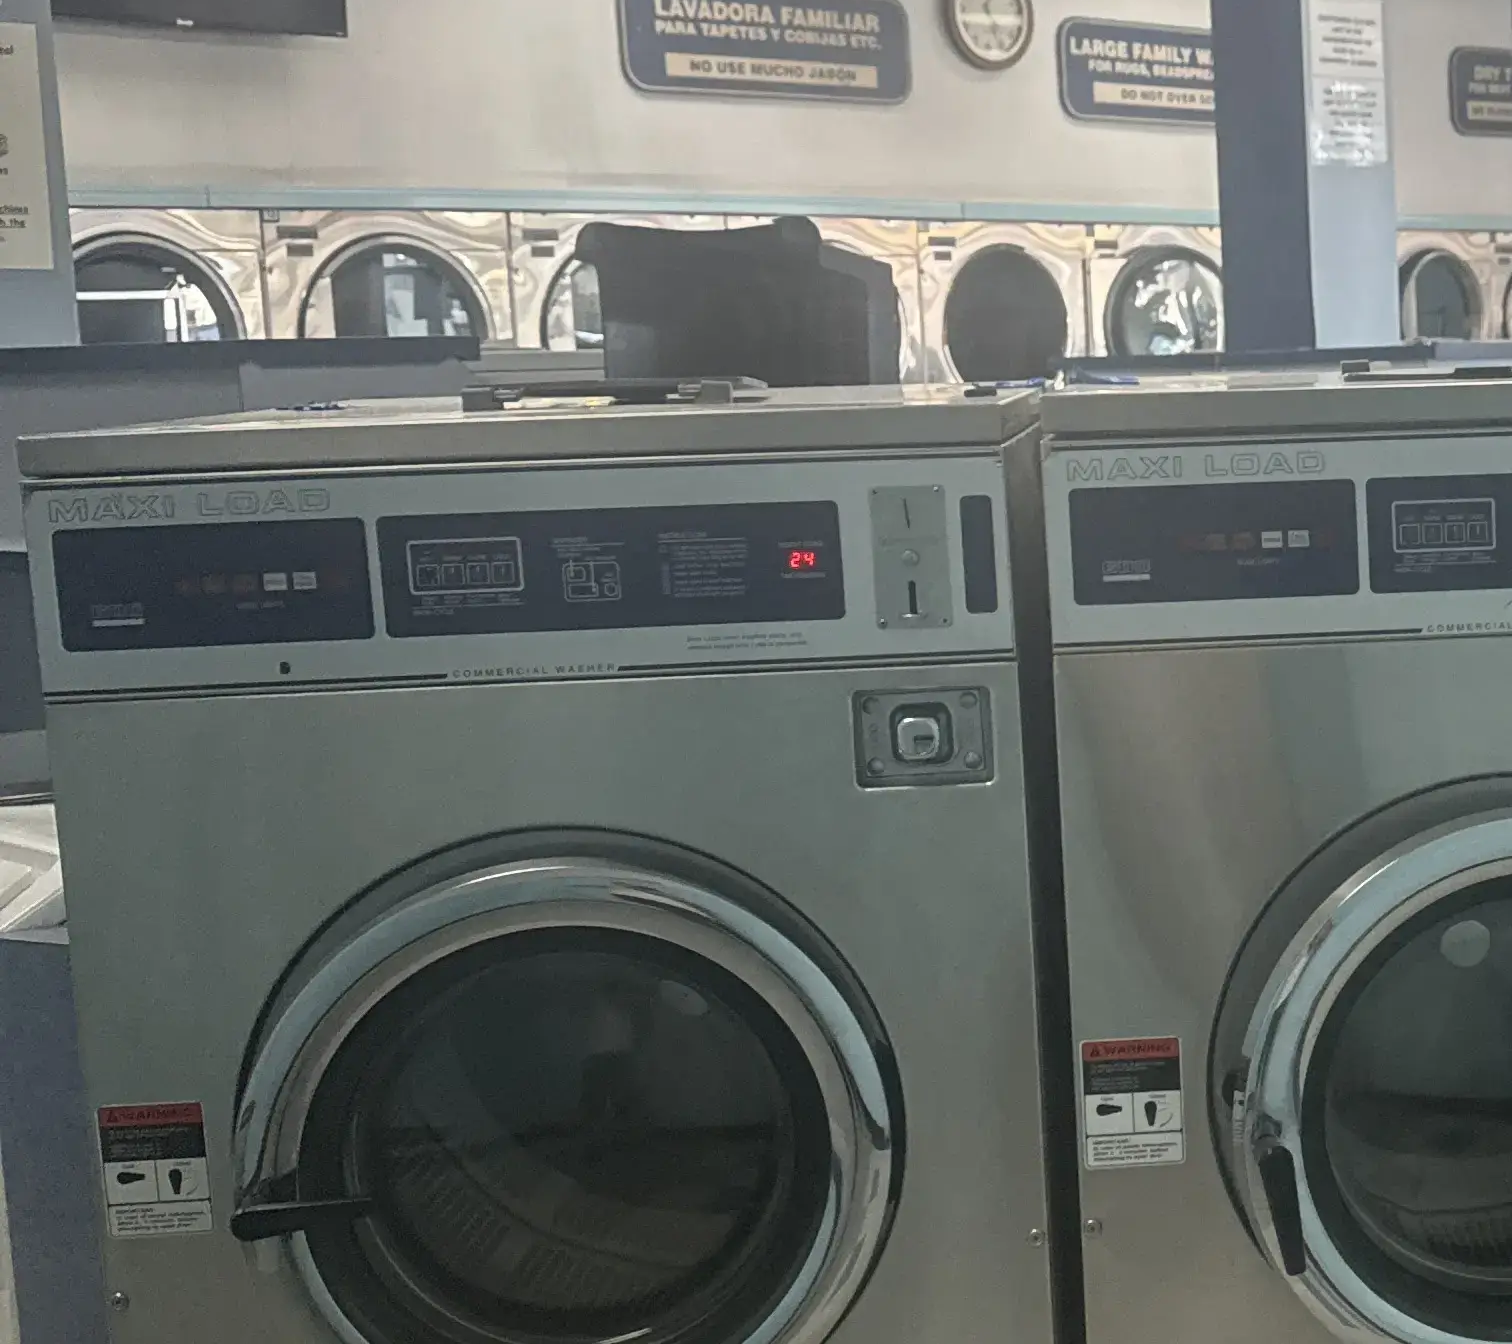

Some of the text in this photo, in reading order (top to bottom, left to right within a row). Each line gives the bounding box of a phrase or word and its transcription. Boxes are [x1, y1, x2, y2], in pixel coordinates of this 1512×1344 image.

[781, 6, 880, 33] FAMILIAR
[655, 20, 697, 36] PARA
[701, 23, 767, 42] TAPETES
[771, 28, 781, 43] Y
[851, 33, 883, 50] ETC.
[1069, 35, 1129, 59] LARGE
[1132, 42, 1193, 65] FAMILY
[689, 58, 712, 73] NO
[717, 60, 746, 75] USE
[751, 63, 804, 79] MUCHO
[1120, 87, 1137, 101] DO
[1139, 90, 1163, 103] NOT
[1166, 91, 1197, 105] OVER
[1066, 451, 1326, 481] MAXI LOAD
[48, 488, 331, 523] MAXI LOAD
[789, 551, 815, 570] 24
[452, 663, 616, 679] COMMERCIAL WASHER
